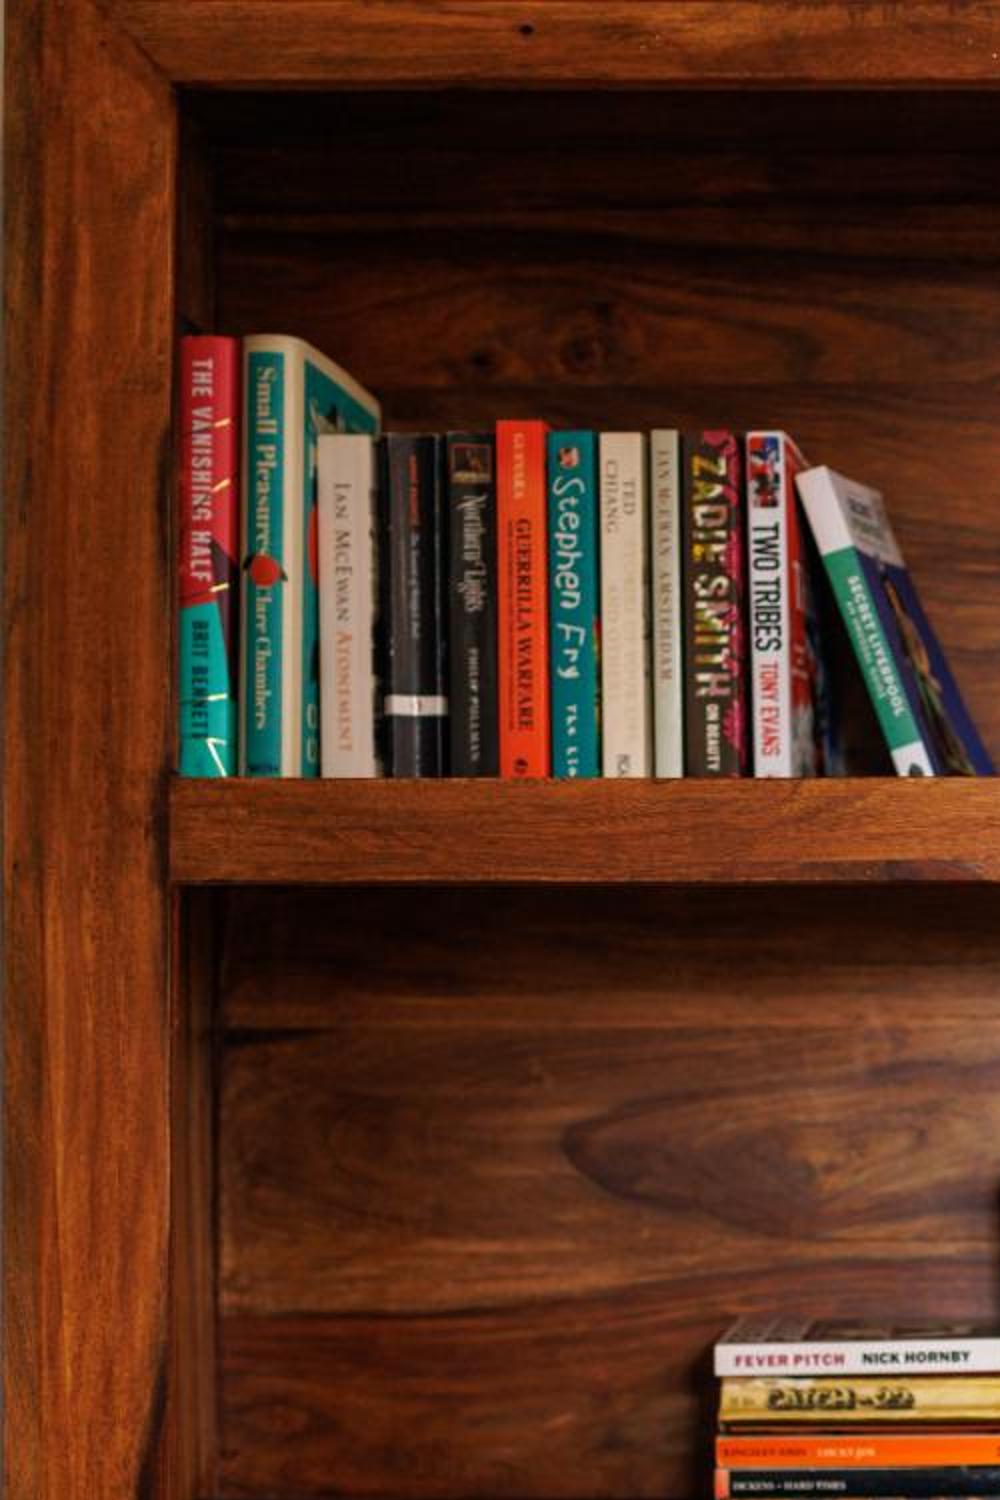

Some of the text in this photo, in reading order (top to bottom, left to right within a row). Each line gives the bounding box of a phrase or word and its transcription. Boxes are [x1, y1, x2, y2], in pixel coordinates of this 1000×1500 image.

[190, 358, 213, 582] THE VANISHING HALF
[255, 366, 278, 556] Small Pleasures
[333, 482, 352, 519] IAN
[604, 459, 620, 534] CHIANG
[622, 479, 636, 516] TED
[456, 493, 488, 613] Northern Lights
[551, 476, 586, 680] Stephen Fry
[691, 454, 731, 697] ZADIE SMITH
[753, 522, 782, 652] TWO TRIBES
[191, 619, 209, 741] BRIT BENNETT
[515, 517, 535, 732] GUERRILLA WARFARE
[658, 570, 673, 681] AMSTERDAM
[846, 575, 876, 631] SECRET
[868, 631, 905, 717] LIVERPOOL
[255, 636, 272, 729] Chambers
[468, 696, 481, 763] PULLMAN
[706, 703, 720, 771] ON BEAUTY
[759, 662, 780, 756] TONY EVANS
[734, 1350, 971, 1368] FEVER PITCH NICK HORNBY
[732, 1479, 847, 1491] DICKENS HARD TIMES
